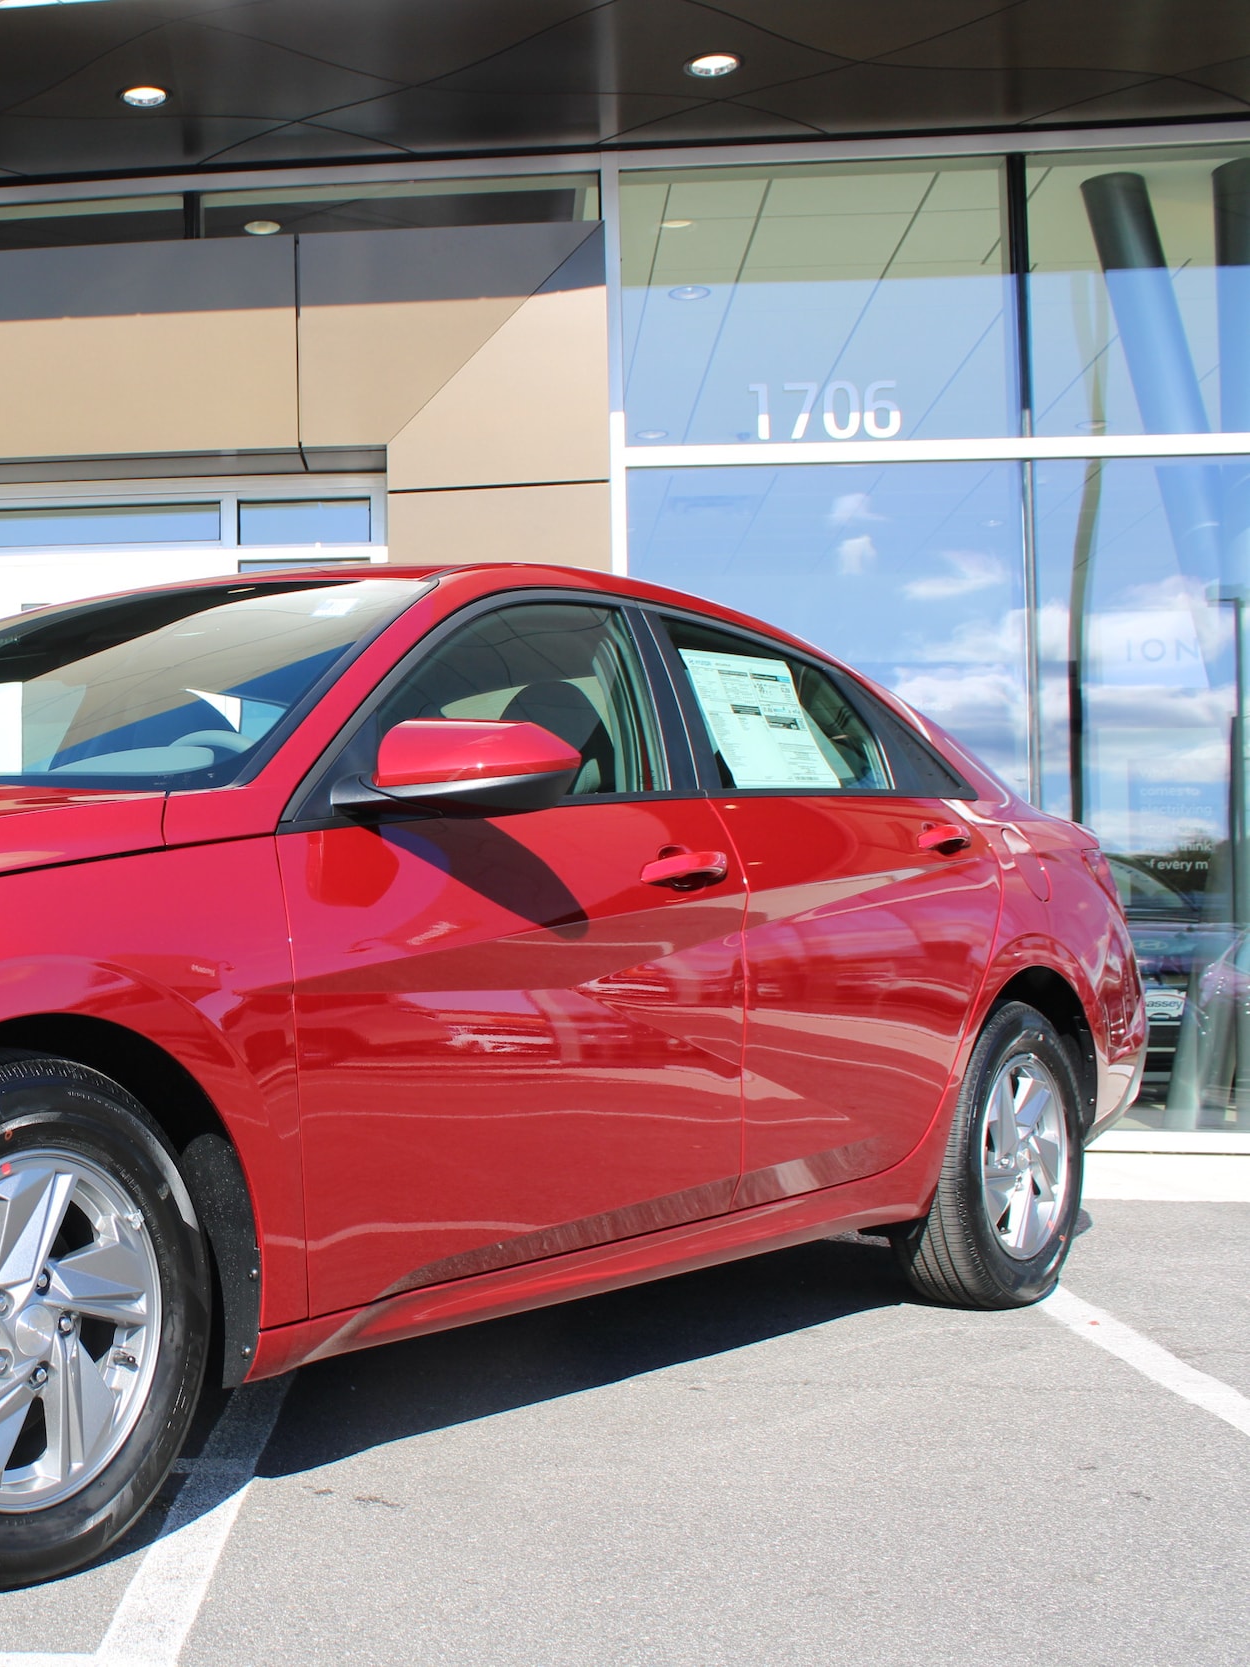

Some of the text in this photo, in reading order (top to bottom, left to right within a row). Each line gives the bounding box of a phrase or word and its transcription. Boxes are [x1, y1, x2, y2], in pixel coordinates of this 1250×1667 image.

[748, 380, 903, 440] 1706
[1157, 860, 1192, 872] every
[1146, 1000, 1183, 1010] assey
